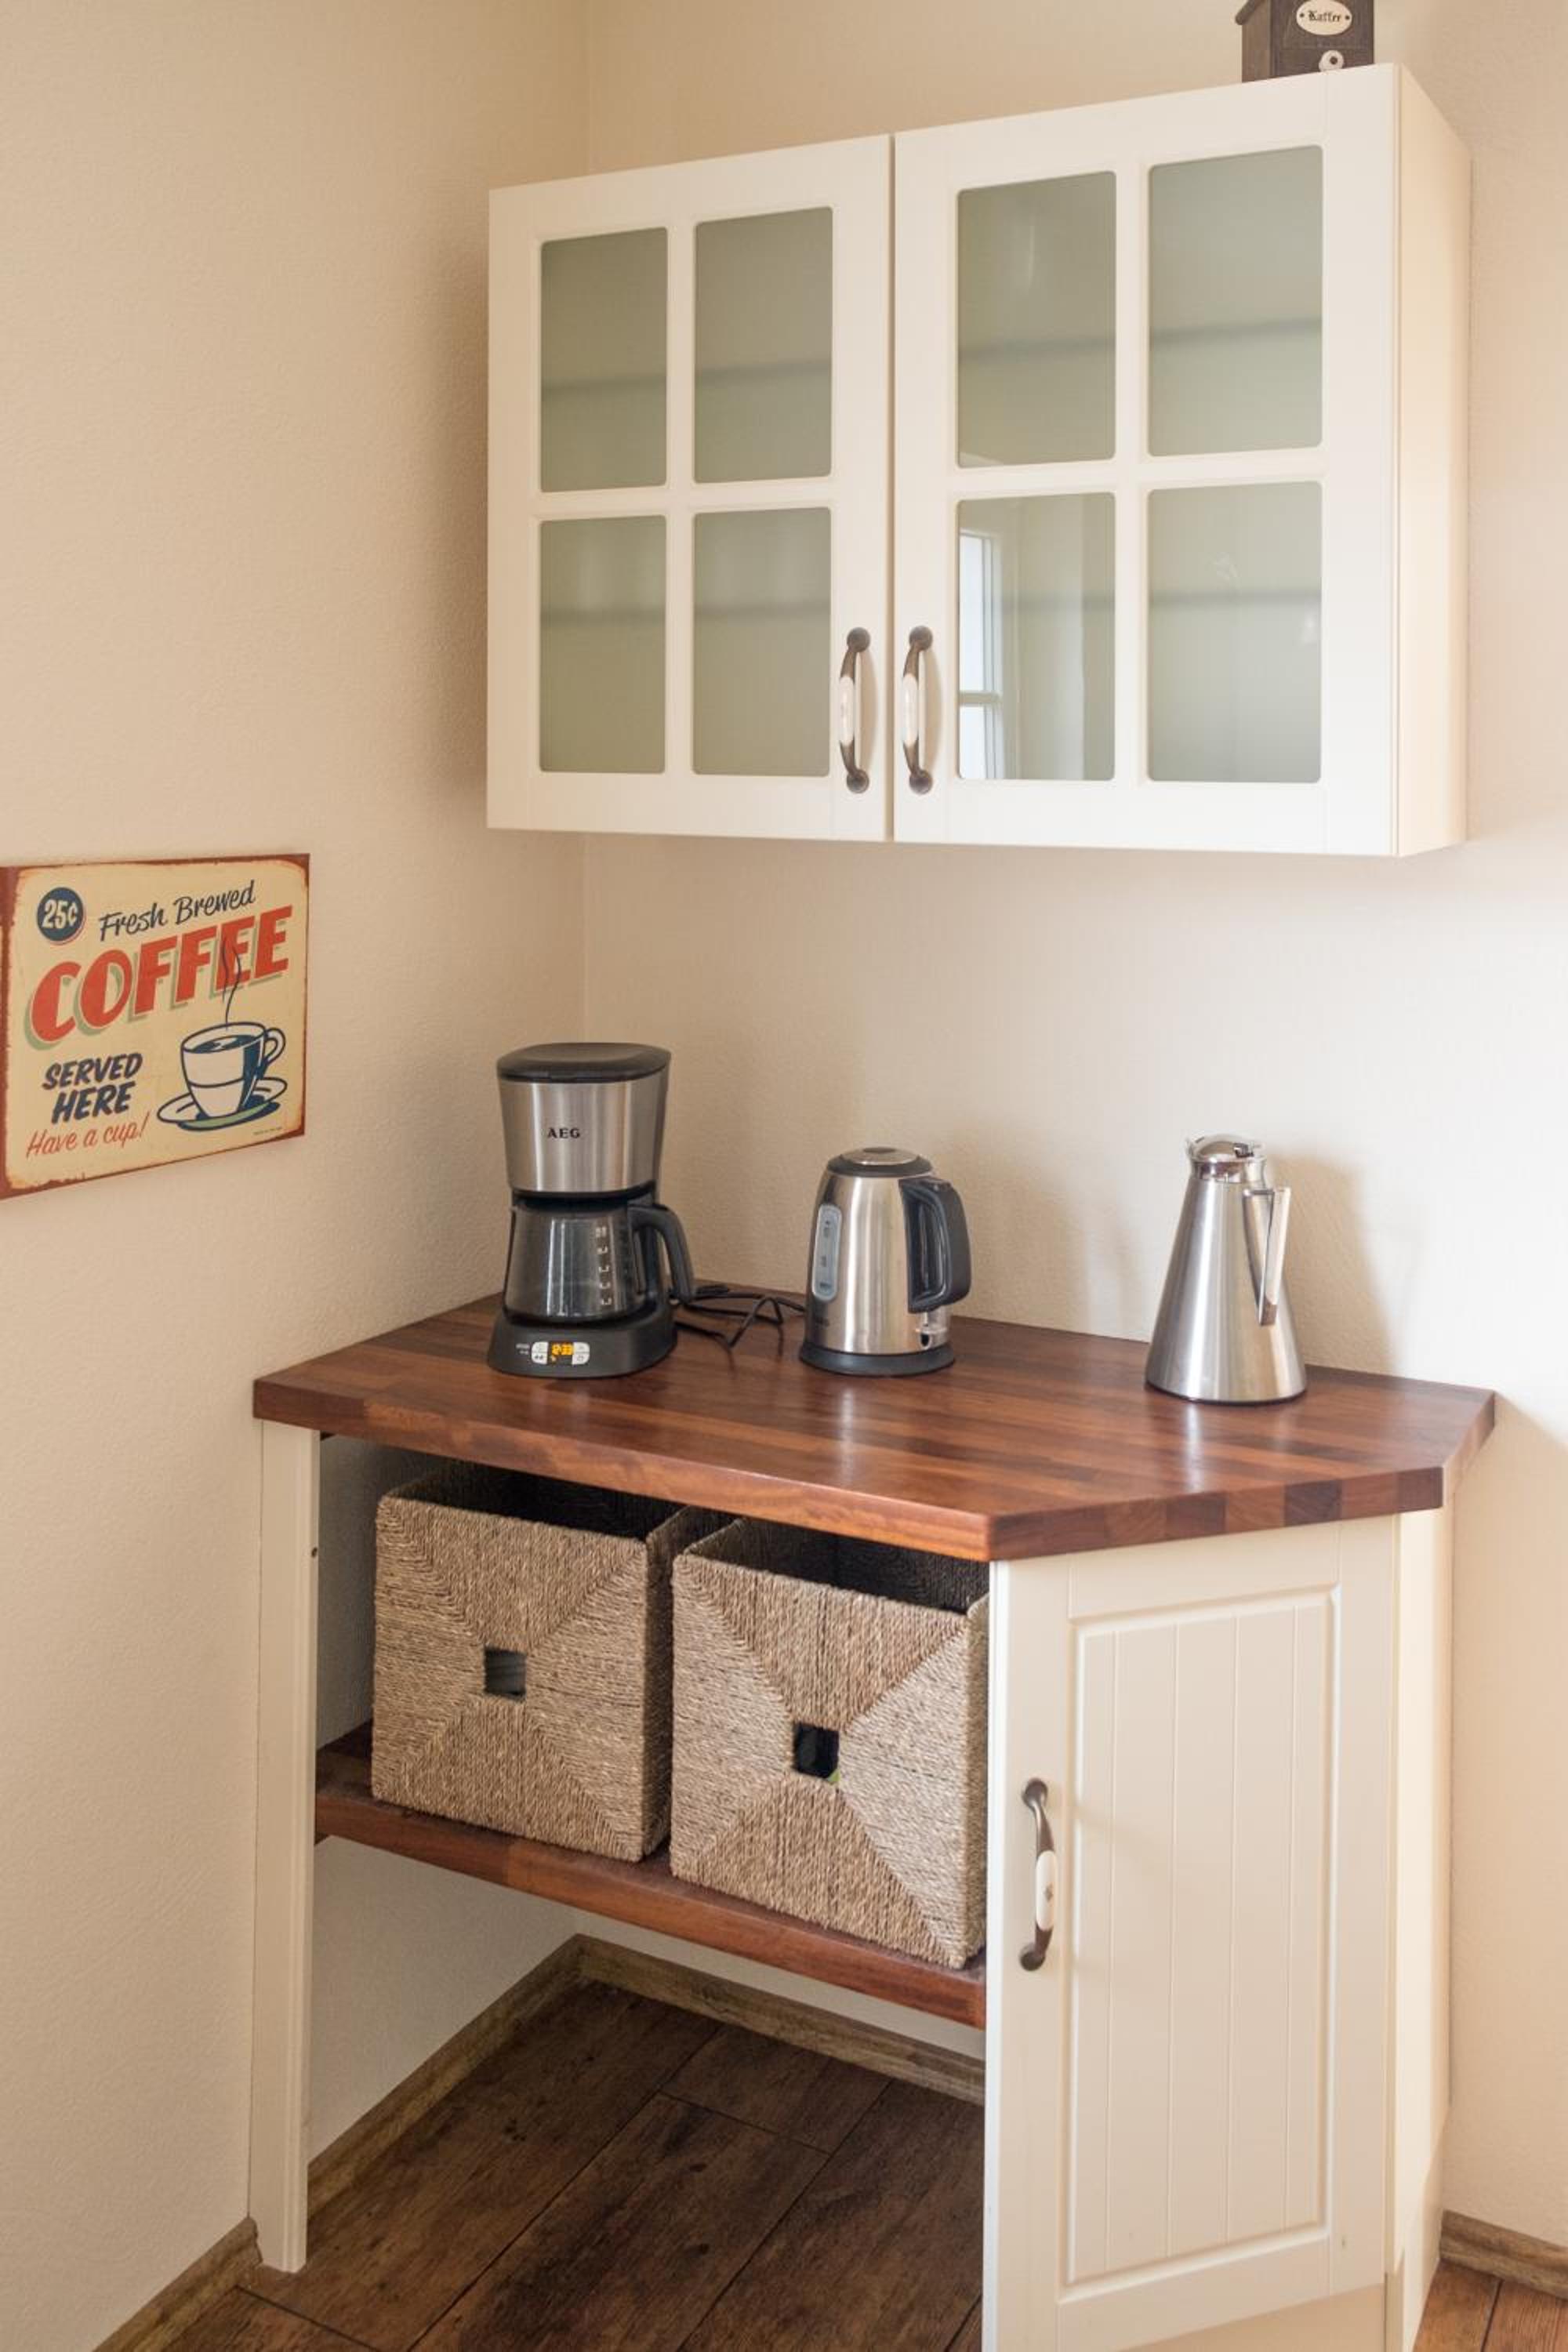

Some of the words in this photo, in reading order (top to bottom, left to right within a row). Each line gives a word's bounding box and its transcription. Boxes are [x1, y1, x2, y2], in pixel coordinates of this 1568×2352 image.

[98, 902, 169, 942] Fresh
[172, 879, 257, 926] Brewed
[31, 904, 293, 1043] COFFEE
[42, 1052, 143, 1090] SERVED
[51, 1080, 136, 1124] HERE
[26, 1128, 78, 1159] Have
[83, 1129, 98, 1148] a
[103, 1110, 151, 1149] cup!
[548, 1127, 581, 1139] AEG
